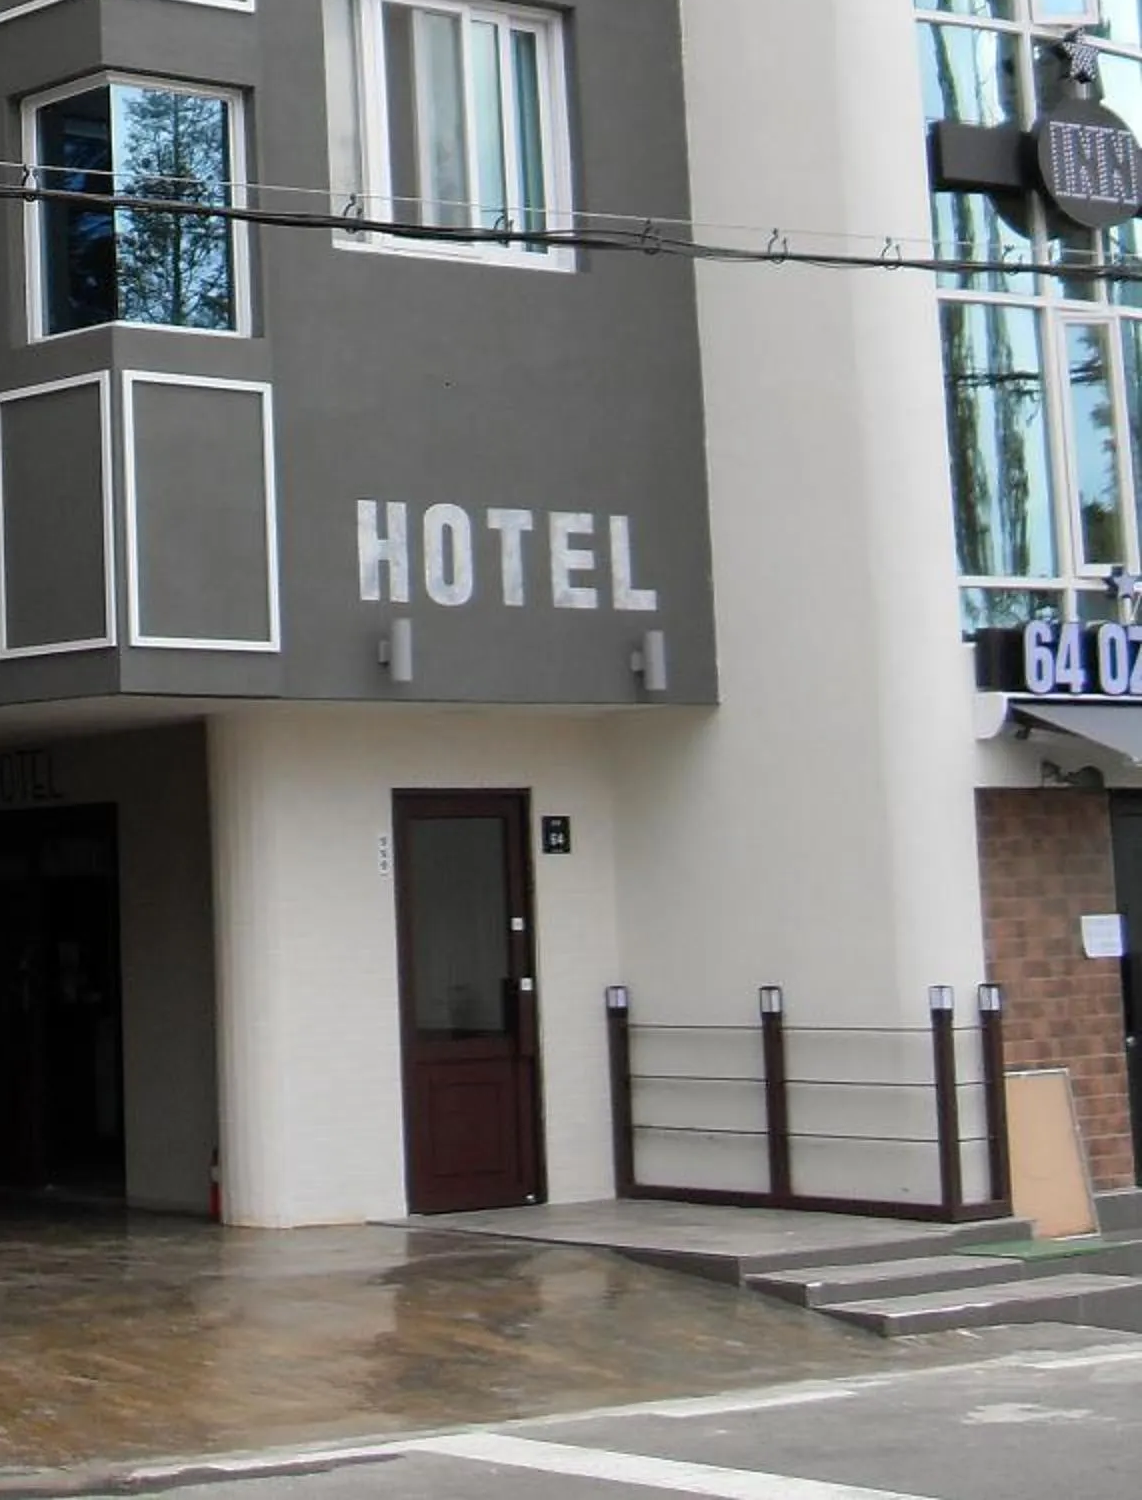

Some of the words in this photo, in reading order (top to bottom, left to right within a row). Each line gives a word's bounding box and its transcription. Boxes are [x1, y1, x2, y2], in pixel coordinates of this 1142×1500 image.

[1049, 121, 1138, 204] INN
[357, 499, 657, 611] HOTEL
[1024, 620, 1086, 693] 64
